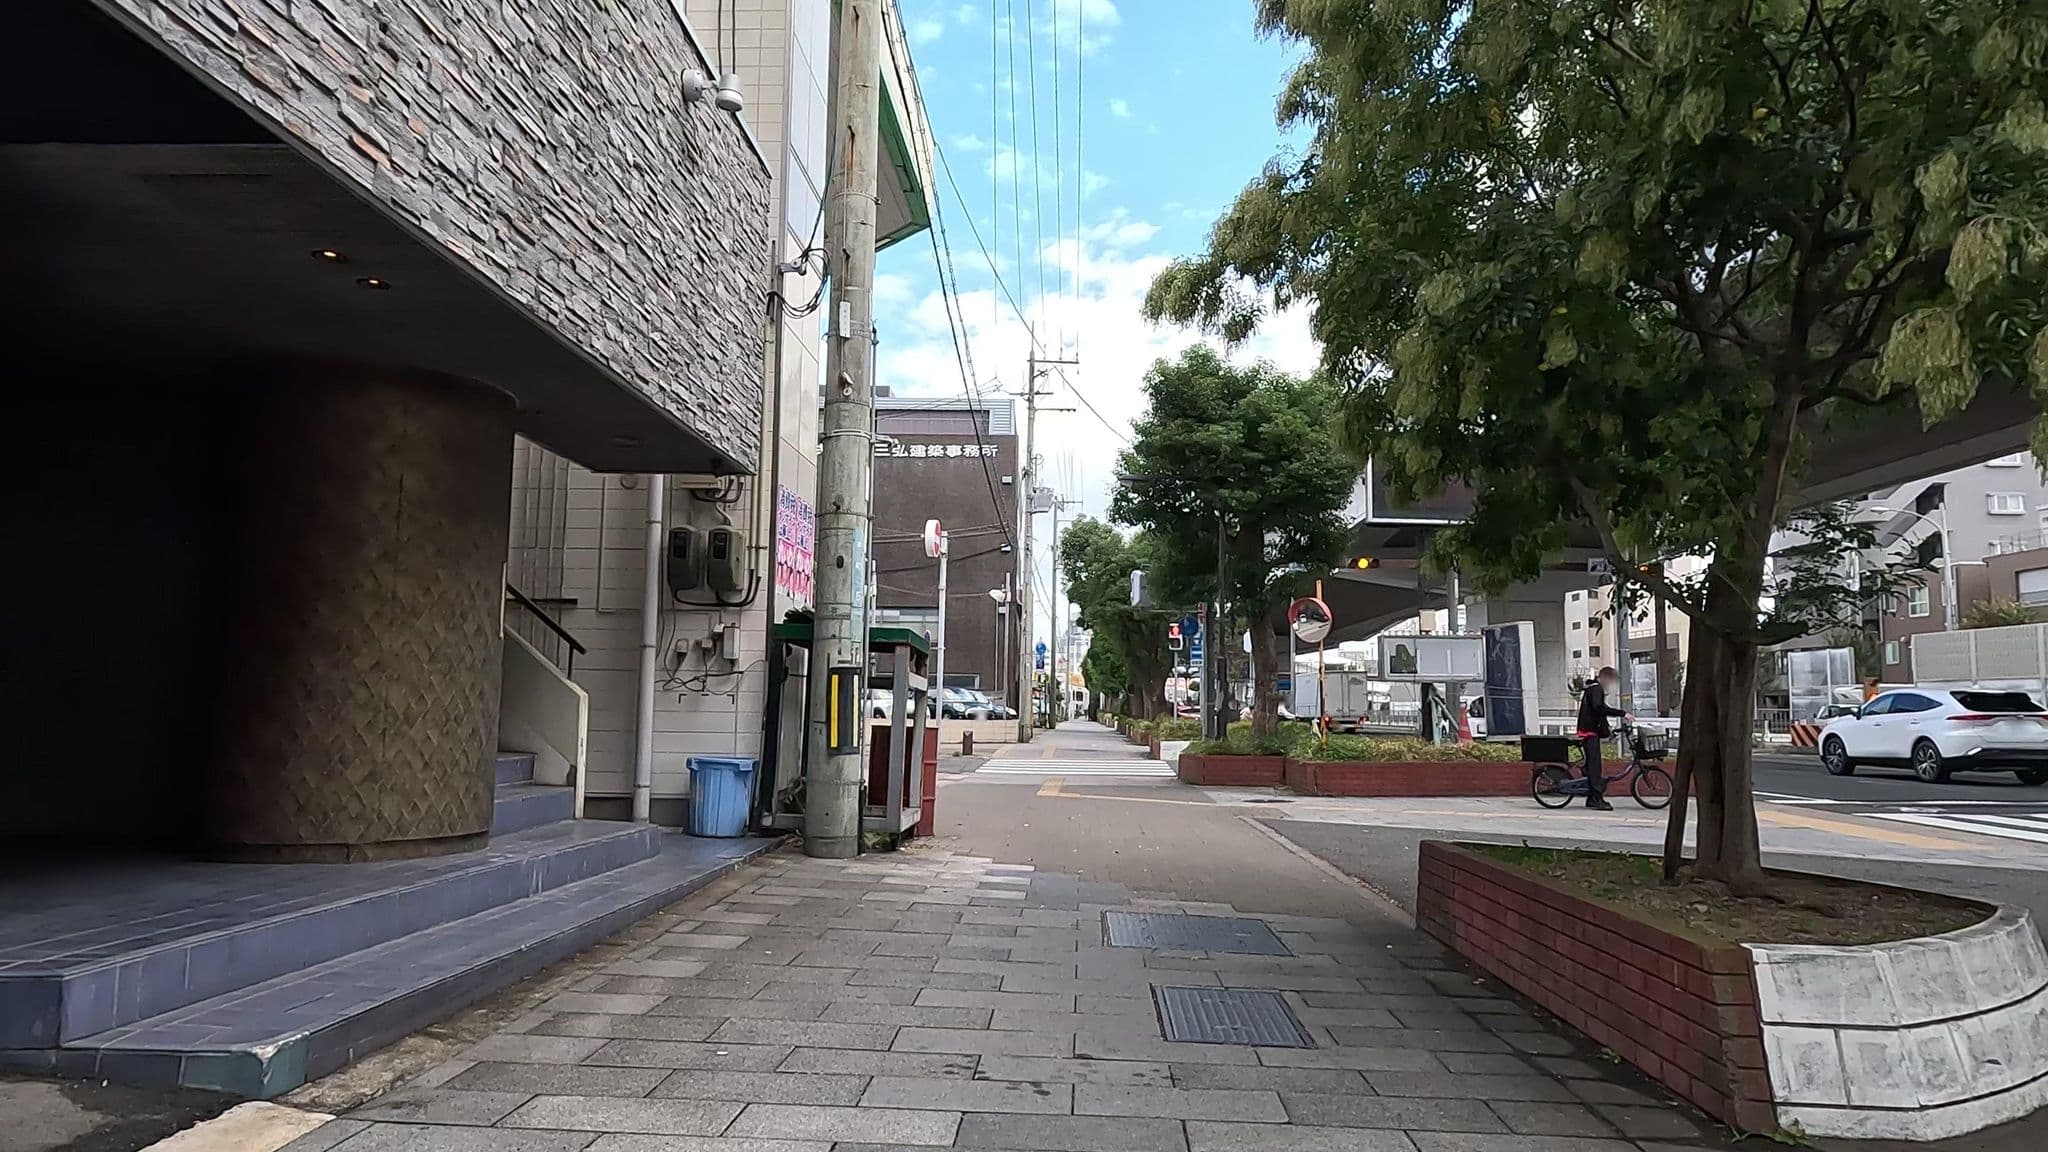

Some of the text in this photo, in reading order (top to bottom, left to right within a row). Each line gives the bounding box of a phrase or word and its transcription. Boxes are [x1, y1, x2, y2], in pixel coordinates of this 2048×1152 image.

[874, 443, 999, 458] 三弘建築事務所
